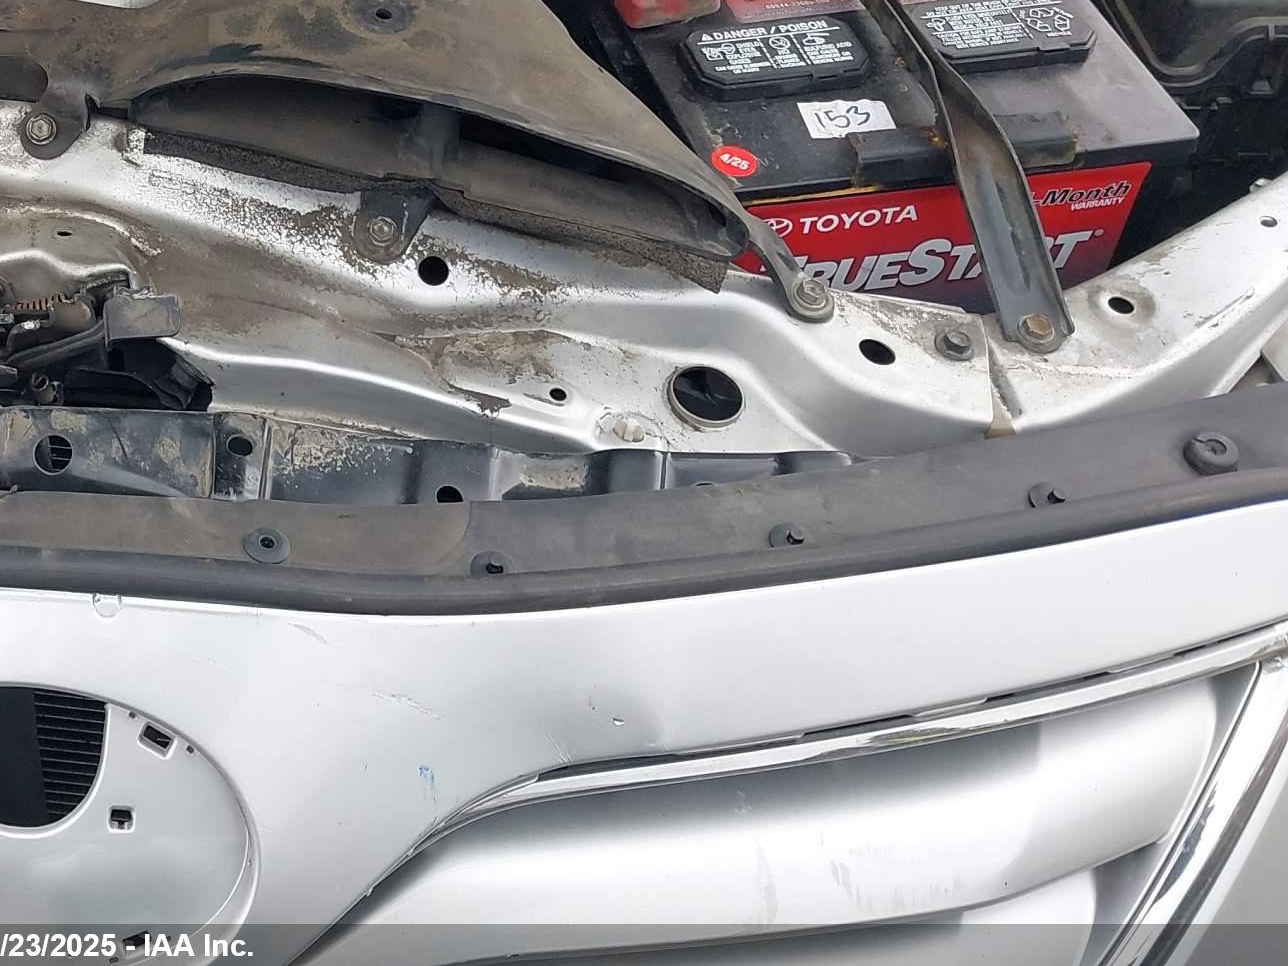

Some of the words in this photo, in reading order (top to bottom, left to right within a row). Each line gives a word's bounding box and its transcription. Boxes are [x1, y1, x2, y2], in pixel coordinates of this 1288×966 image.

[712, 27, 767, 41] DANGER
[769, 26, 776, 35] /
[779, 20, 829, 33] POISON
[814, 105, 871, 129] 153
[719, 153, 750, 171] 4/25
[1071, 196, 1125, 211] WARRANTY
[799, 204, 918, 235] TOYOTA
